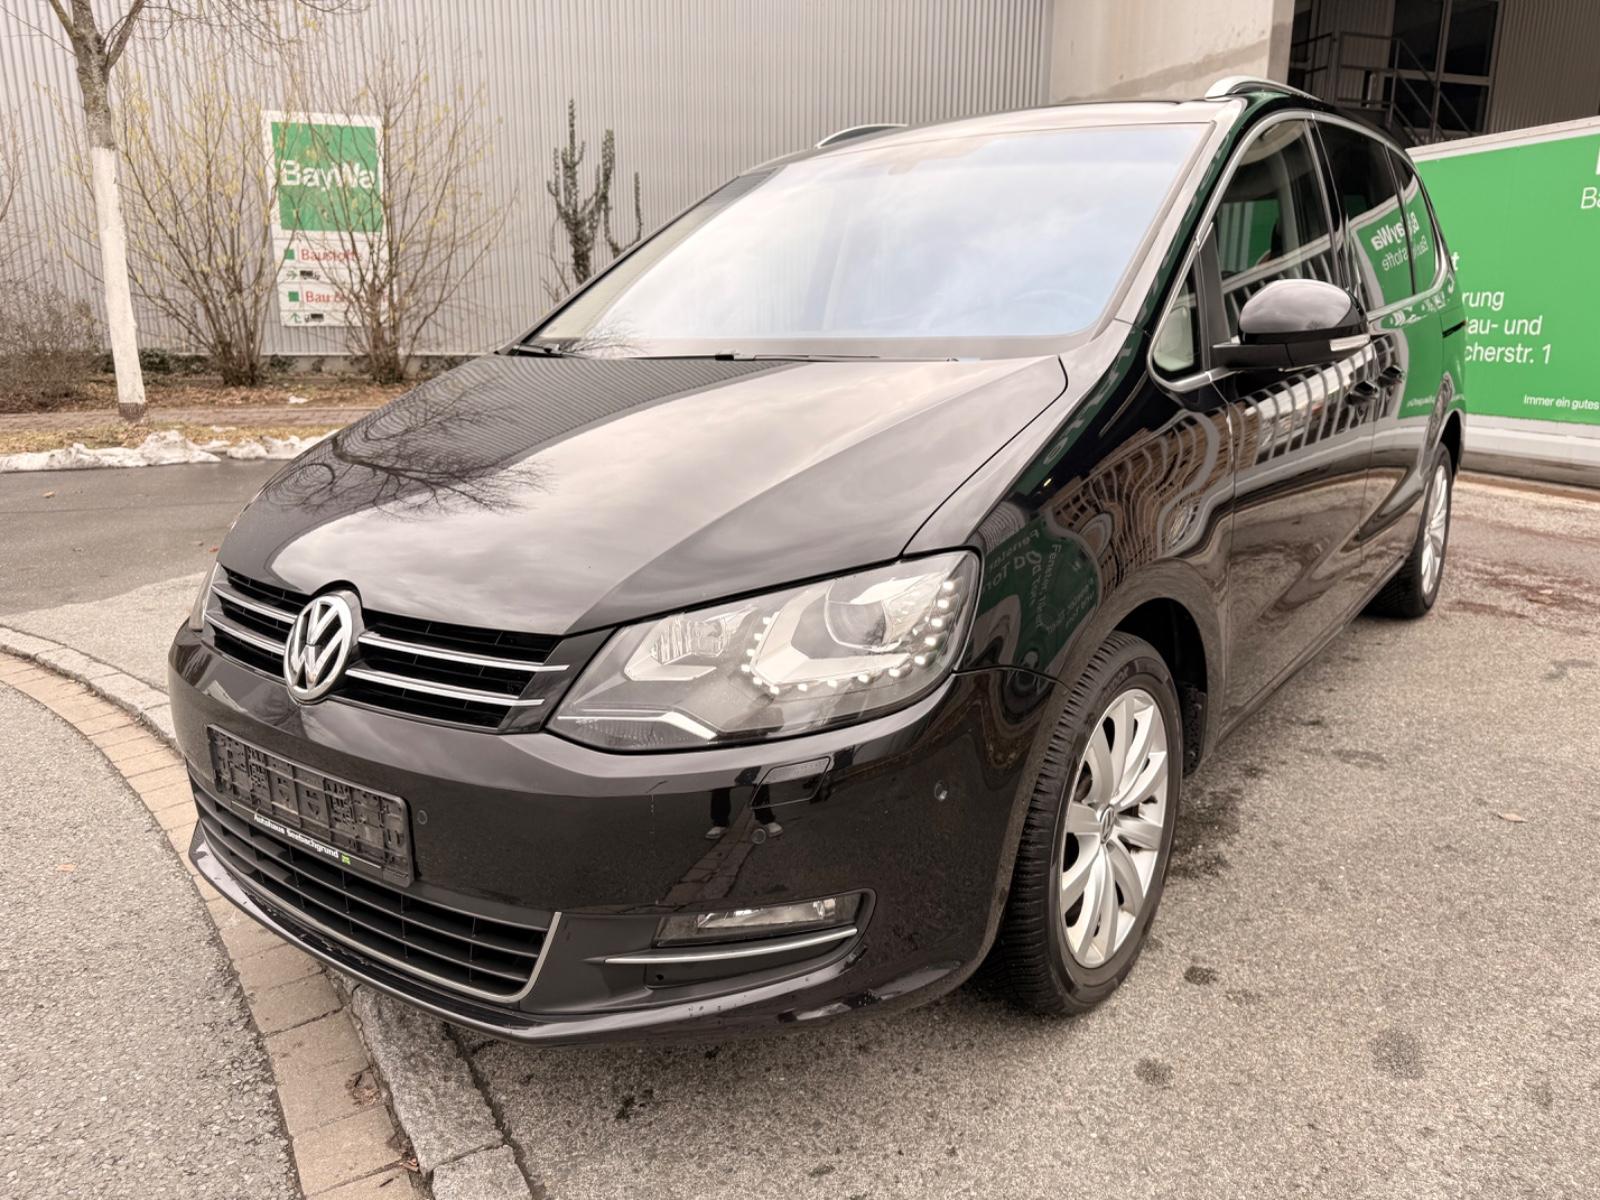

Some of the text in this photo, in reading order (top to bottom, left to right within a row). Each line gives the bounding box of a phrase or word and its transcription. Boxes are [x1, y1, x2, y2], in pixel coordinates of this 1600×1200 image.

[280, 160, 375, 191] BayWa
[1581, 186, 1600, 209] B
[1466, 315, 1543, 335] au- und
[1542, 343, 1551, 365] 1
[1523, 394, 1600, 411] Immer ein gutes
